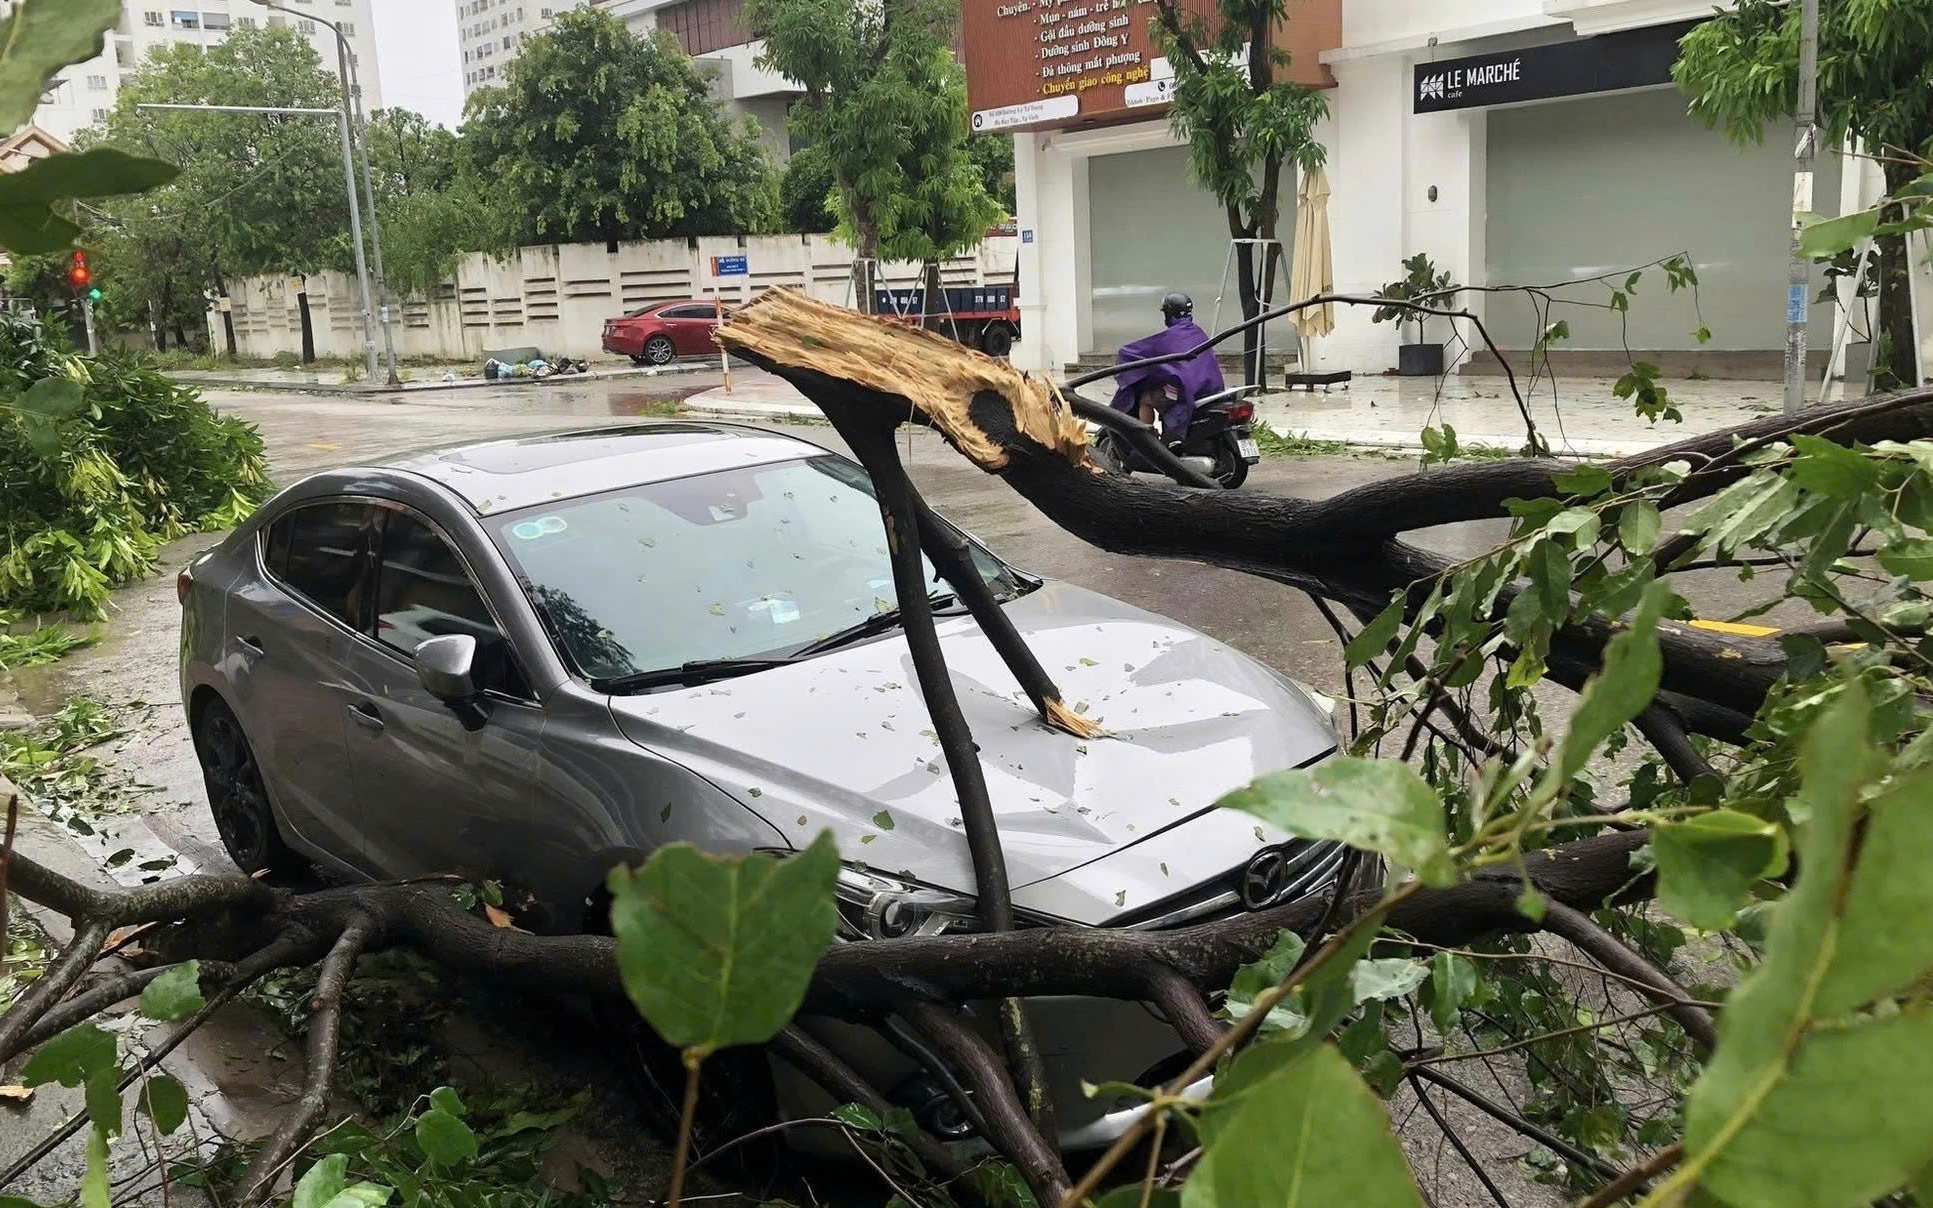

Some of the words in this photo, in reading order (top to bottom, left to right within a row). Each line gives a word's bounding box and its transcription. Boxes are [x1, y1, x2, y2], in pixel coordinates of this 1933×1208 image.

[1040, 31, 1056, 43] Gội
[1109, 14, 1129, 28] sinh
[1072, 40, 1090, 54] sinh
[1121, 33, 1129, 45] Y
[1057, 61, 1082, 75] thông
[1447, 69, 1462, 89] LE
[1466, 58, 1521, 87] MARCHÉ
[1079, 77, 1098, 91] giao
[1101, 71, 1122, 86] công
[1447, 90, 1463, 99] cafe
